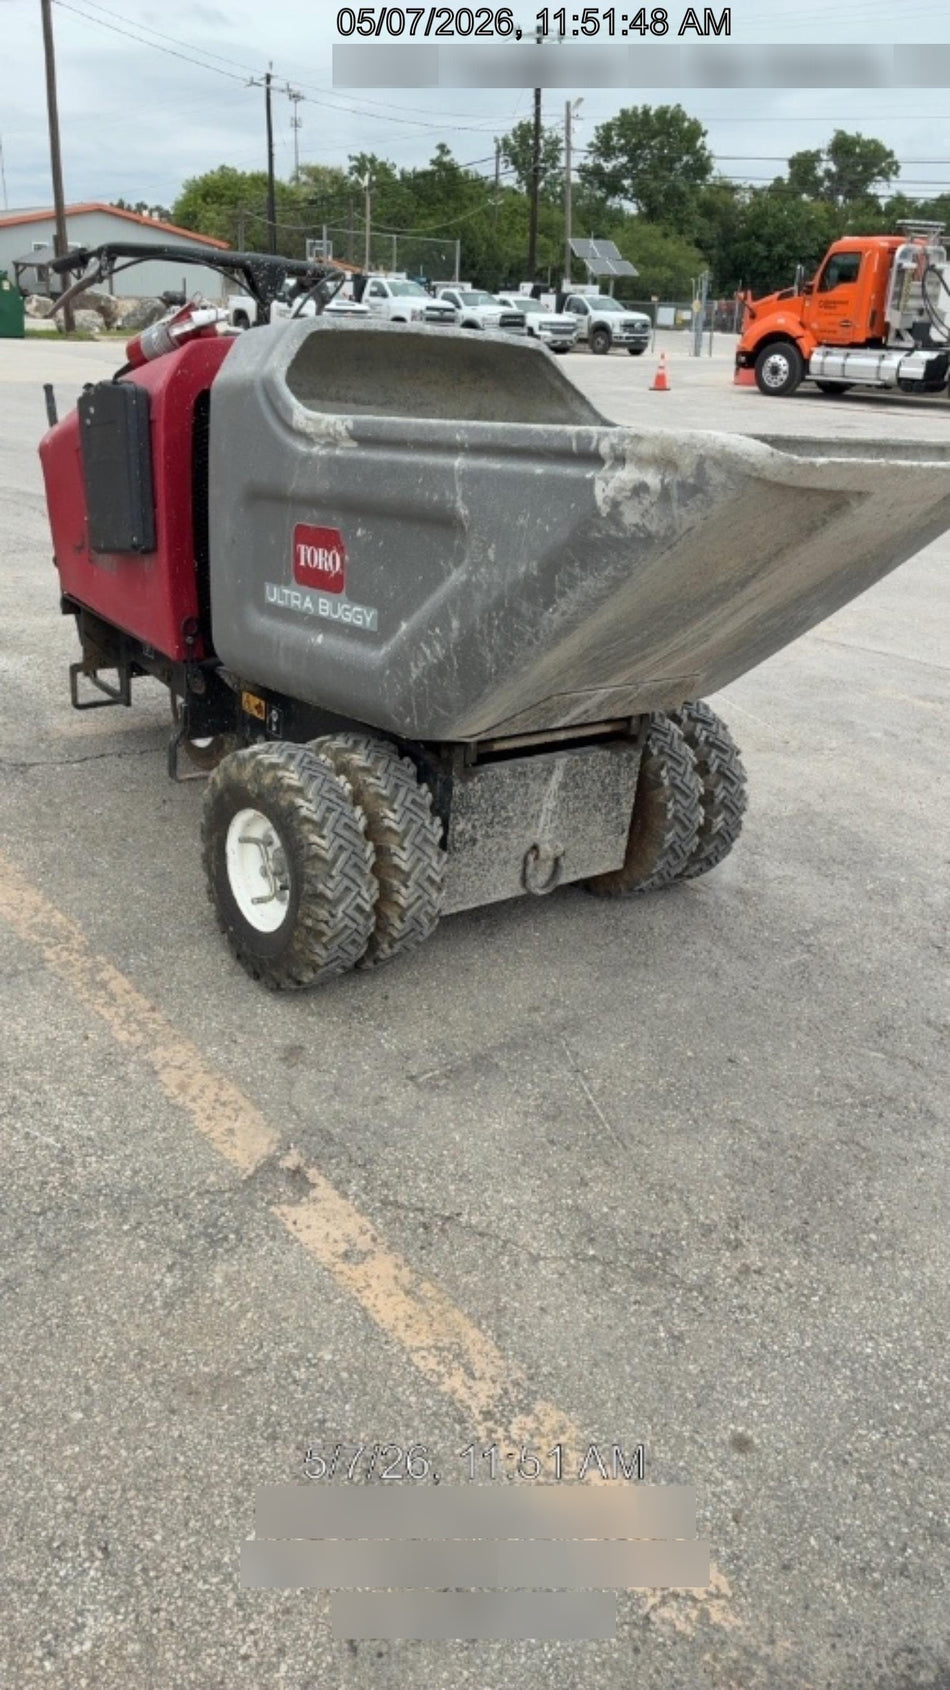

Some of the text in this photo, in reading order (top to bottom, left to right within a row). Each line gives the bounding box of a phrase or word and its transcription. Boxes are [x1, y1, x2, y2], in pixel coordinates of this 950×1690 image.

[296, 544, 341, 573] TORO
[265, 585, 375, 627] ULTRA BUGGY
